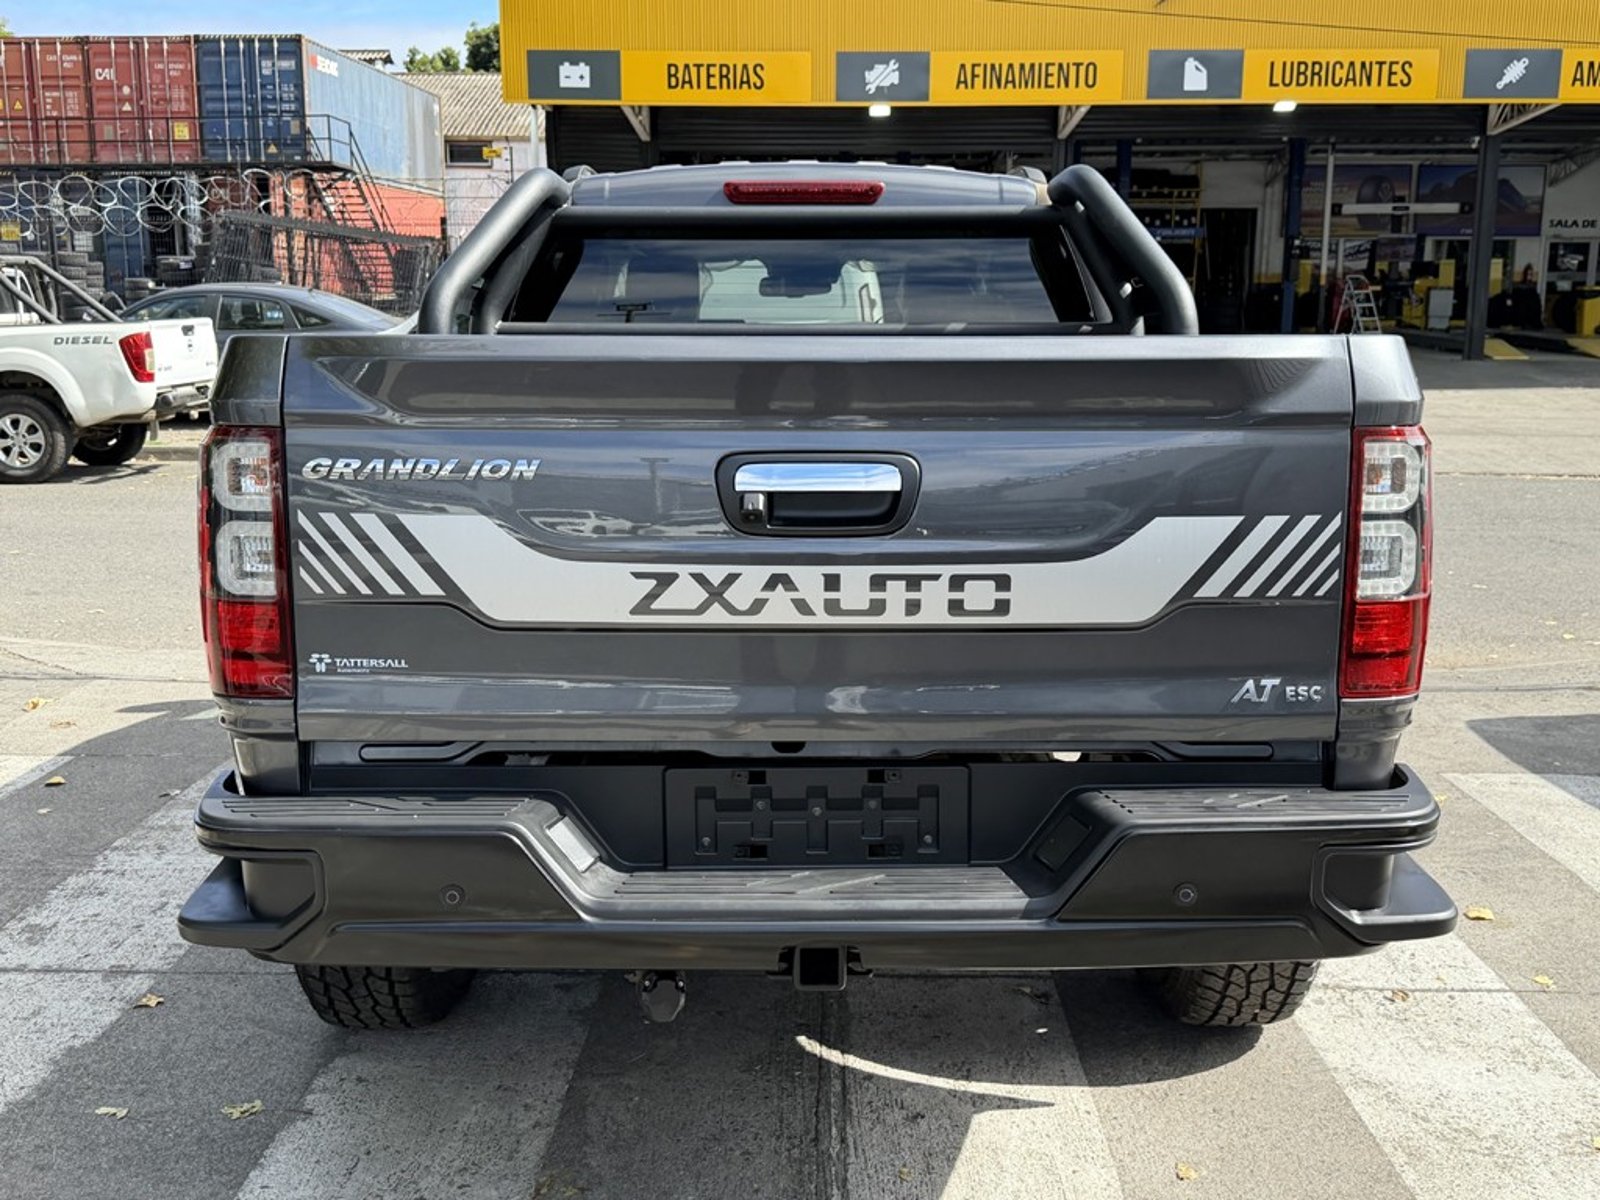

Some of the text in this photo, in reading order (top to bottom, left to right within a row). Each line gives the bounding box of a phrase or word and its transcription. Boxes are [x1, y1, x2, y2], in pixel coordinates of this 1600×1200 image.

[666, 63, 765, 91] BATERIAS
[955, 62, 1098, 90] AFINAMIENTO
[1268, 60, 1413, 88] LUBRICANTES
[1549, 219, 1597, 228] SALA DE
[53, 336, 114, 345] DIESEL
[301, 457, 541, 481] GRANDLION
[628, 571, 1013, 617] ZXAUTO
[334, 658, 408, 668] TATTERSALL
[1230, 677, 1322, 703] AT ESC
